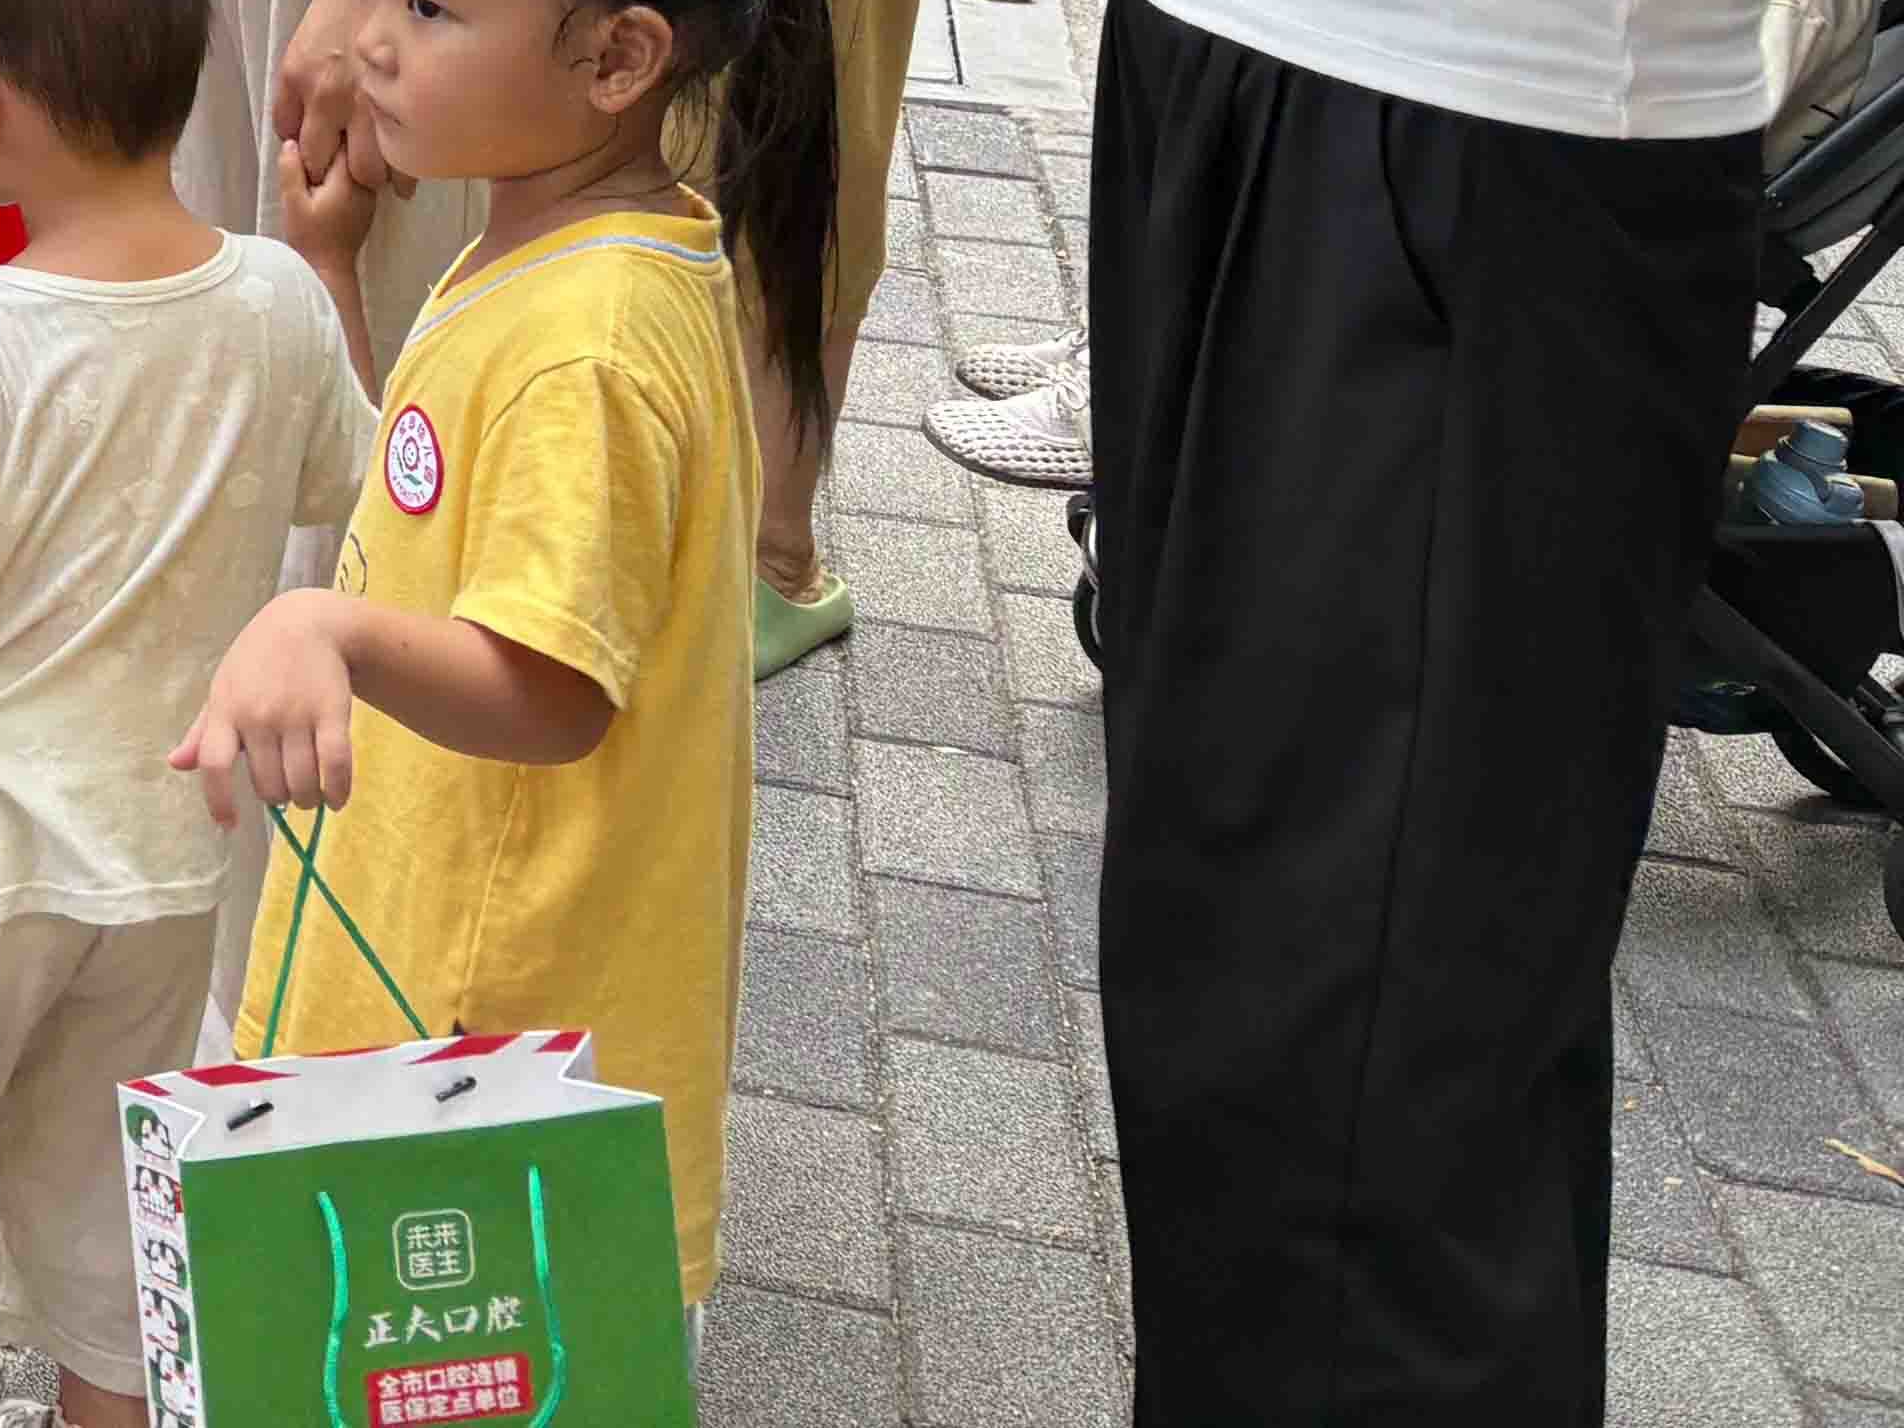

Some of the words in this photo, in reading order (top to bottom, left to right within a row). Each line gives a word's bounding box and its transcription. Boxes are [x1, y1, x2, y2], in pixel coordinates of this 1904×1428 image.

[406, 1221, 461, 1249] 未来
[409, 1250, 464, 1279] 医生
[363, 1295, 526, 1349] 正大口腔
[380, 1385, 522, 1426] 医保定点单位
